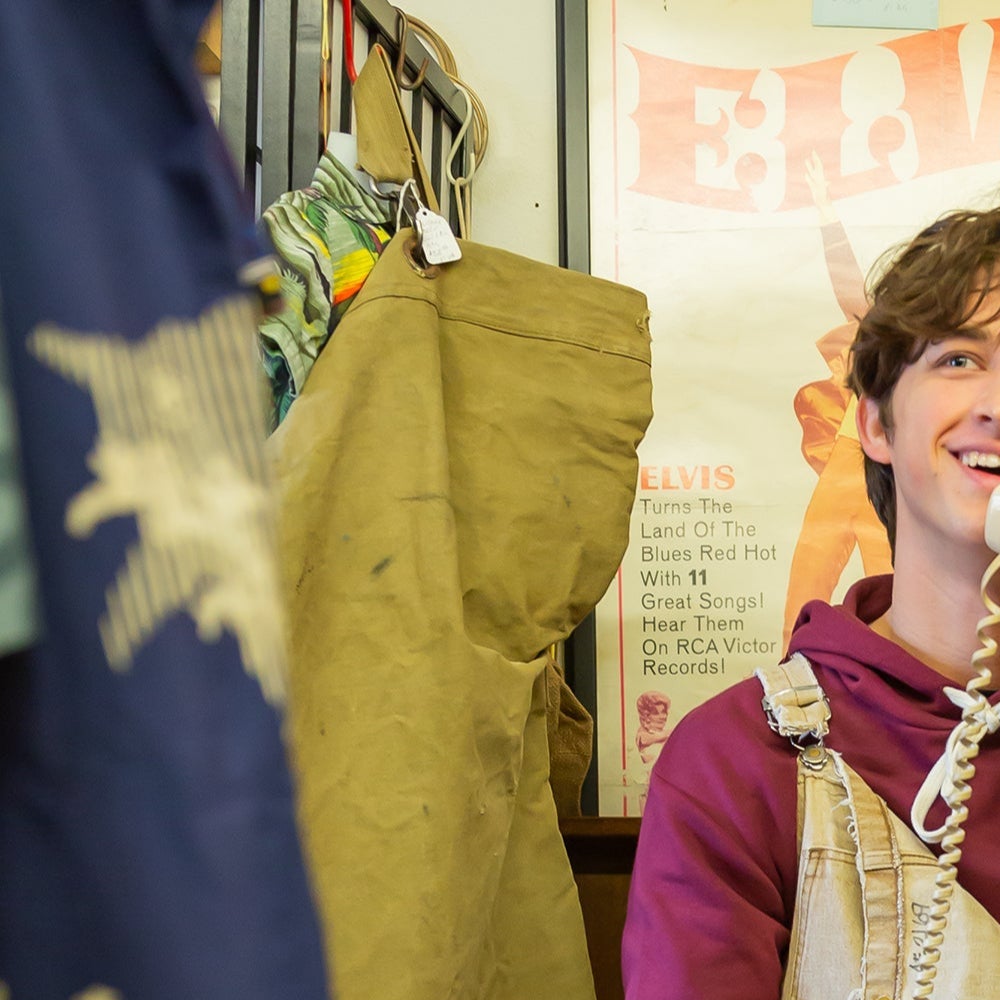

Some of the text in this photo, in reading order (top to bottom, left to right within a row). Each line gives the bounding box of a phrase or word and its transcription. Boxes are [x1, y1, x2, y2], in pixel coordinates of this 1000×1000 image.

[640, 465, 735, 491] ELVIS
[640, 498, 733, 515] Turns The
[641, 520, 757, 539] Land Of The
[641, 544, 777, 562] Blues Red Hot
[641, 569, 708, 586] With 11
[641, 592, 764, 613] Great Songs!
[642, 615, 744, 632] Hear Them
[642, 638, 777, 655] On RCA Victor
[643, 660, 726, 676] Records!
